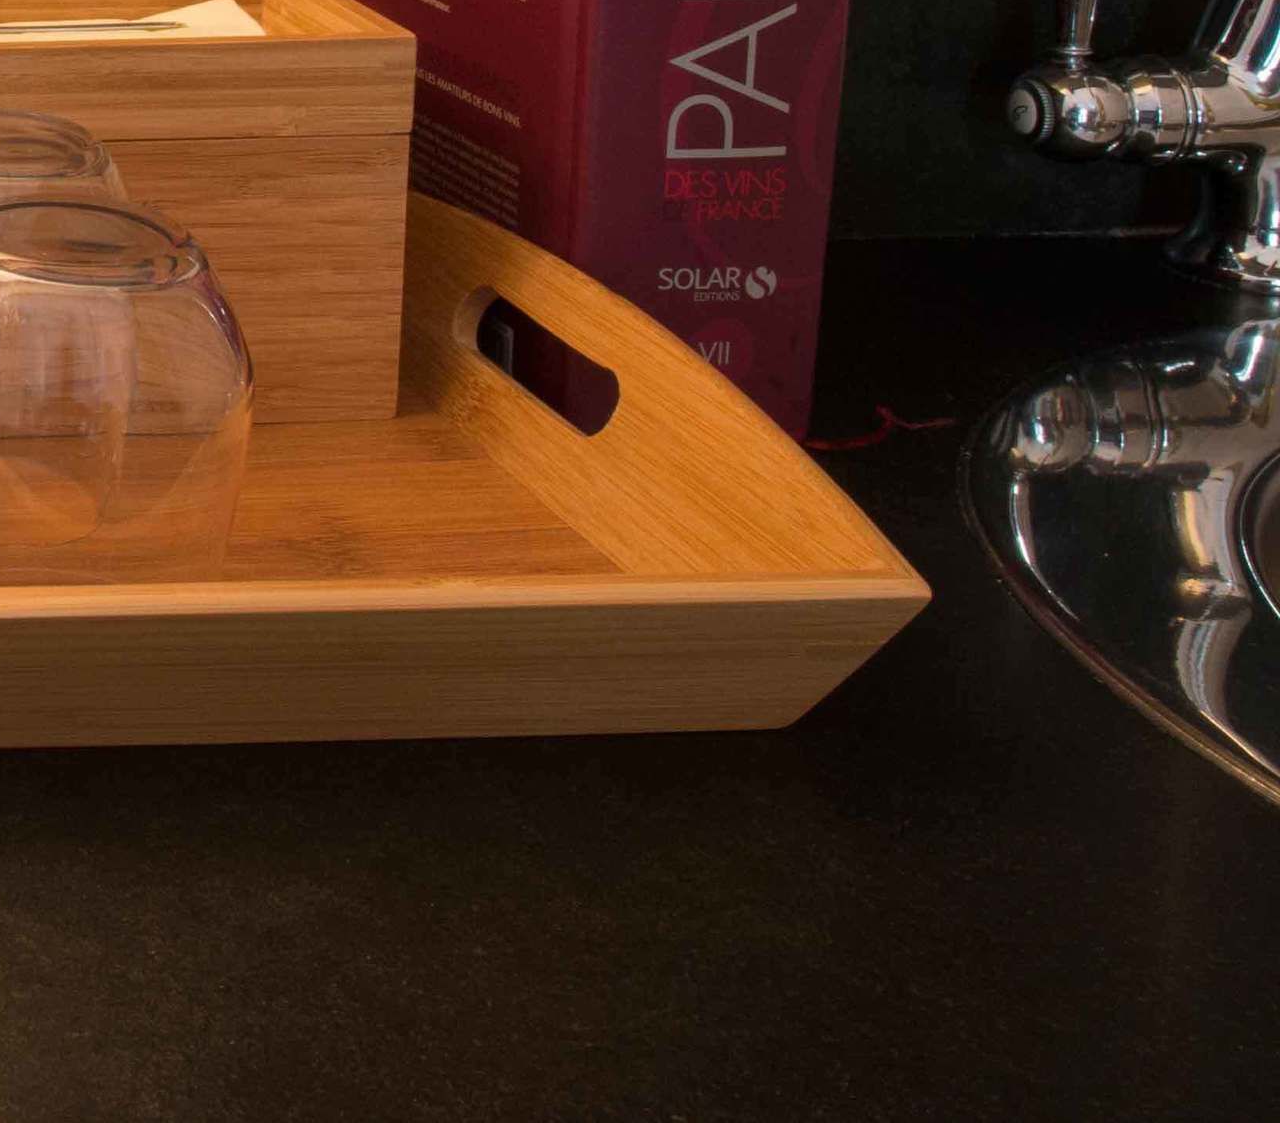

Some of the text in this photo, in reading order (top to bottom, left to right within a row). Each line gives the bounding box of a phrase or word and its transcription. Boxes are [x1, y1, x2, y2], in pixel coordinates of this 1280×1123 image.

[437, 77, 472, 103] AMATEURS
[473, 94, 482, 108] DE
[483, 99, 503, 119] BONS
[664, 168, 786, 198] DES VINS
[697, 198, 784, 221] FRANCE
[658, 267, 740, 290] SOLAR
